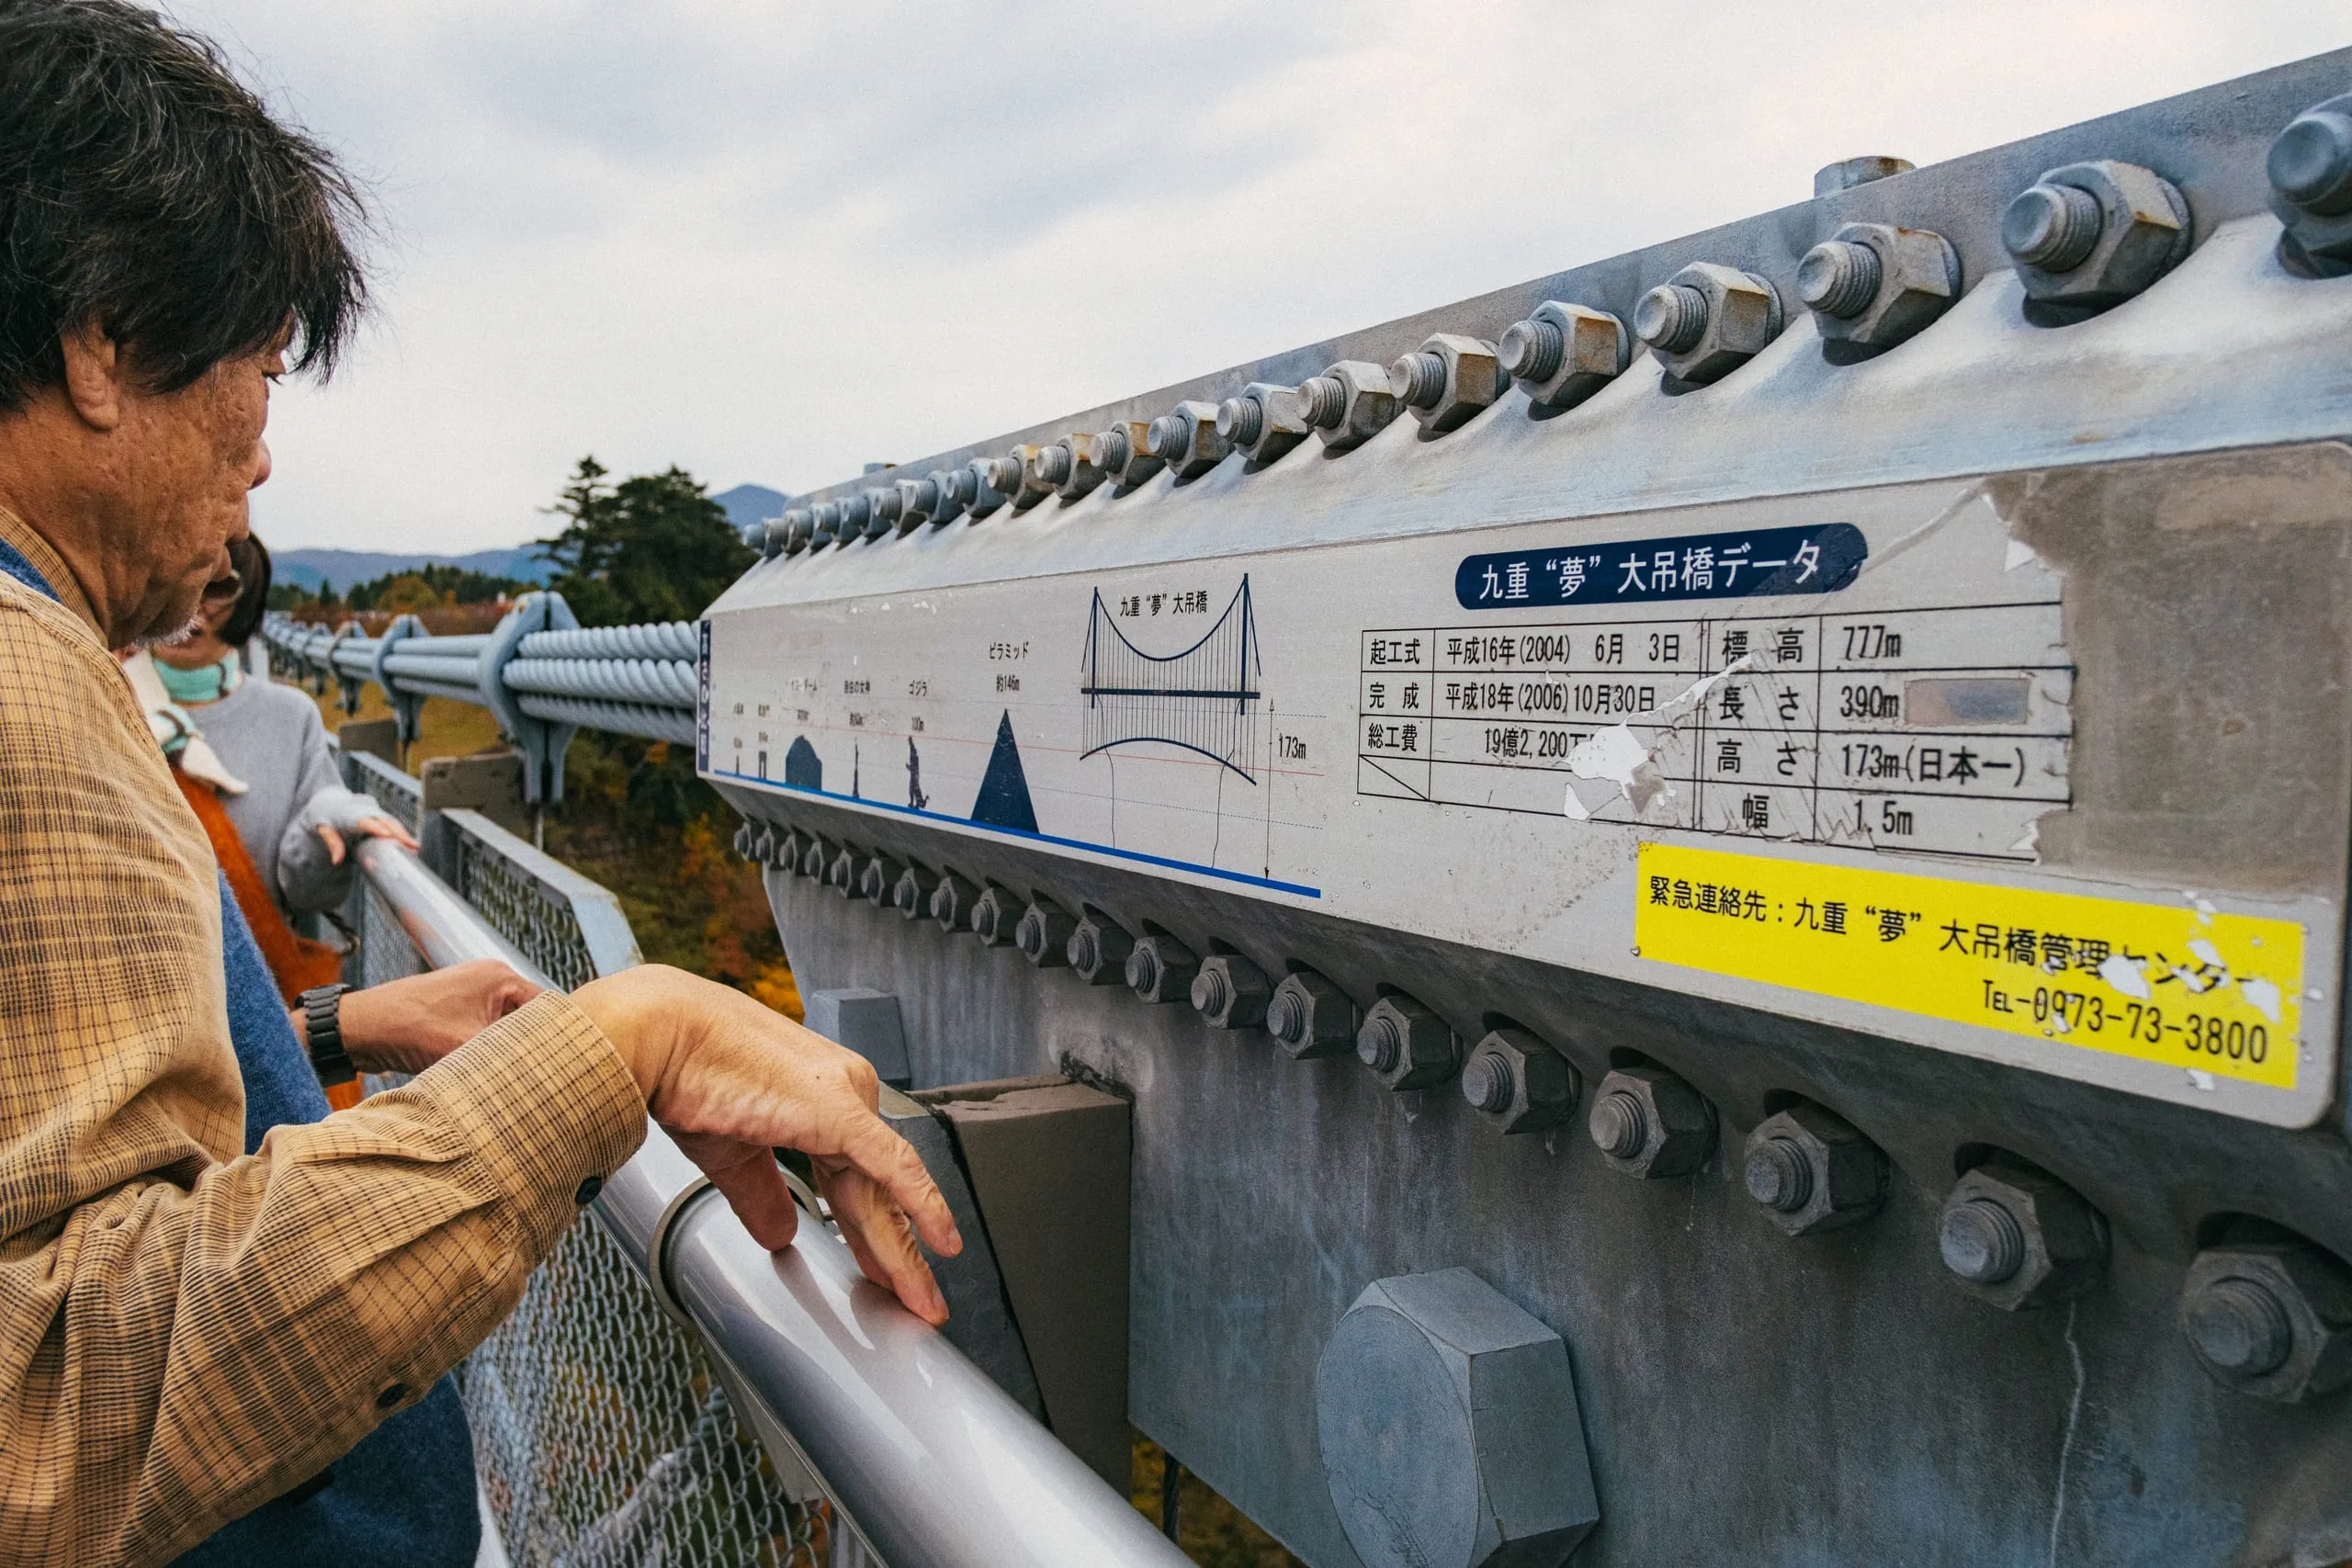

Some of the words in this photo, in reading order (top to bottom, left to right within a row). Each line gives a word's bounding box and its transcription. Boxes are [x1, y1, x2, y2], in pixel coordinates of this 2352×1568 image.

[989, 640, 1029, 660] ピラミッド
[1370, 638, 1420, 665] 起工式
[1446, 634, 1571, 666] 平成16年(2004)
[1595, 634, 1624, 664] 6月
[1649, 634, 1679, 663] 3日
[1842, 624, 1902, 660] 777m
[909, 679, 927, 697] ゴジラ
[996, 673, 1020, 693] 約146m
[1839, 684, 1899, 718] 390m
[1278, 735, 1306, 760] 173m
[1367, 723, 1419, 753] 総工費
[1841, 743, 2027, 788] 173m(日本一)
[1742, 793, 1770, 829] 幅
[1854, 799, 1913, 836] 1.5m
